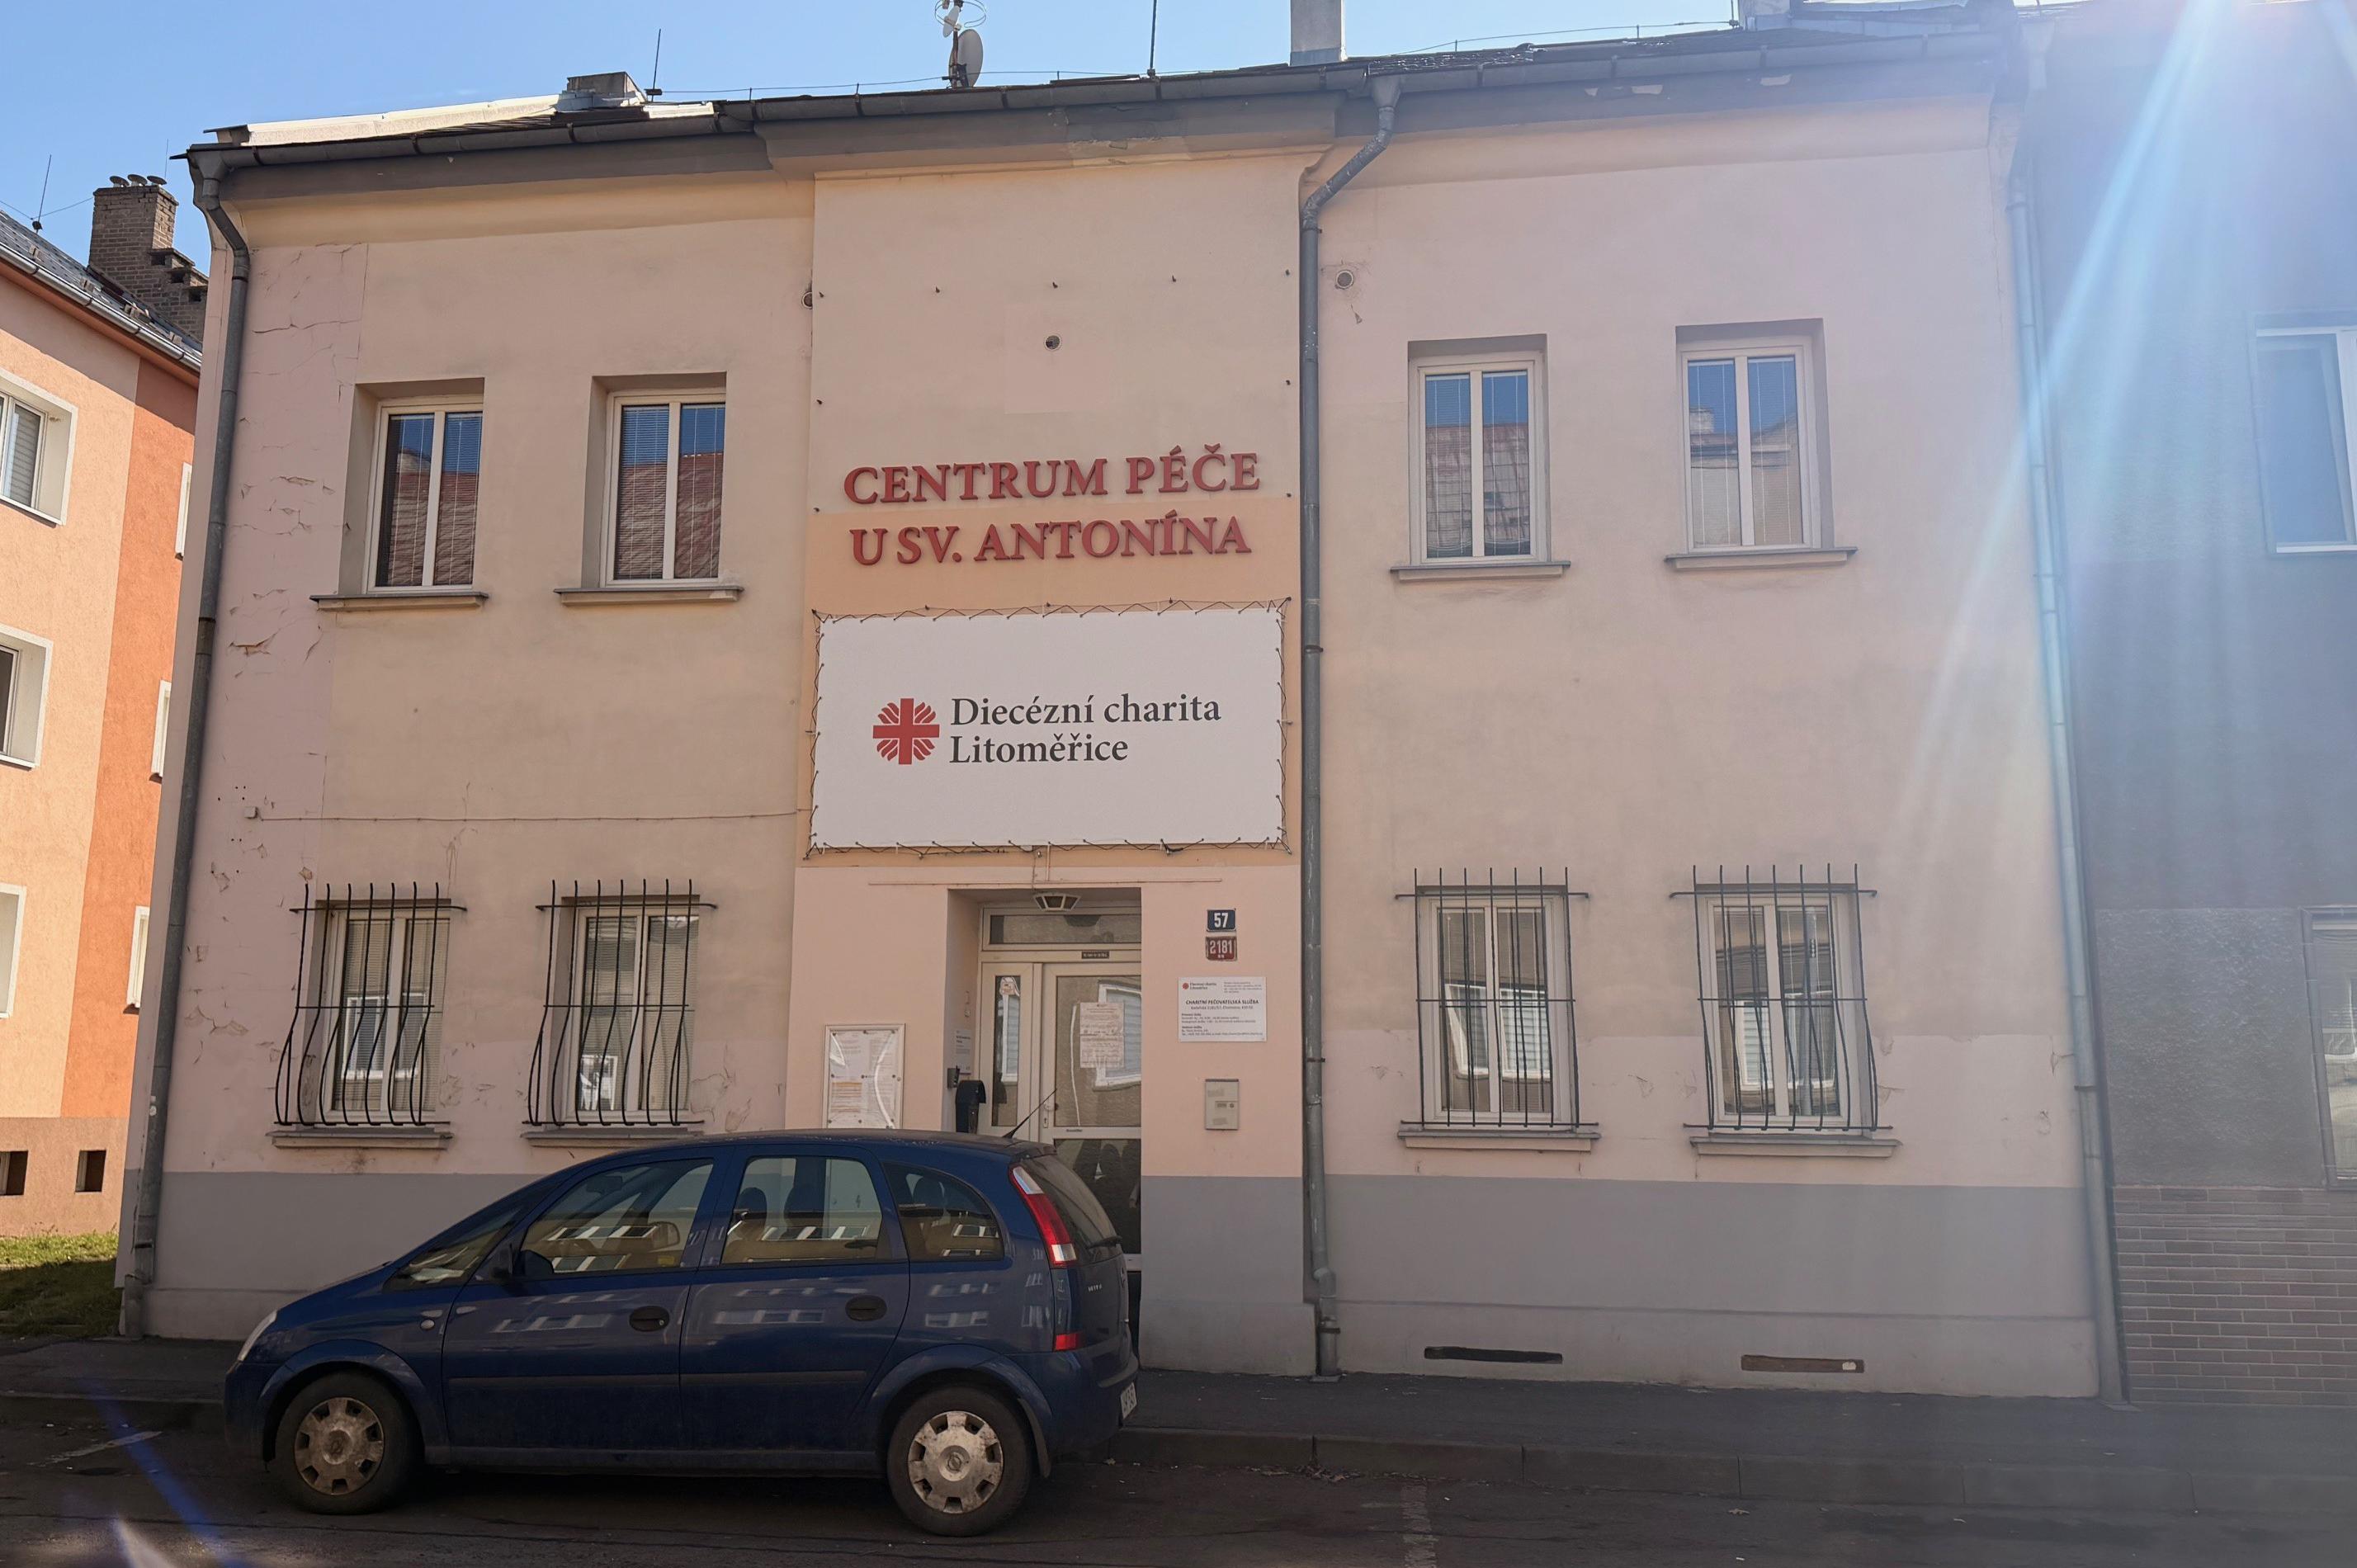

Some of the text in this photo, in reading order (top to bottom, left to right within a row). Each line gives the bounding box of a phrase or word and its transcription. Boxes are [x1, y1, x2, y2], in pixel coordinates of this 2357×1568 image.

[843, 442, 1260, 505] CENTRUM PÉČE
[849, 508, 1252, 566] U SV. ANTONÍNA
[950, 692, 1221, 725] Diecézní charita
[949, 732, 1128, 763] Litoměřice
[1213, 912, 1229, 928] 57
[1209, 939, 1233, 955] 2181
